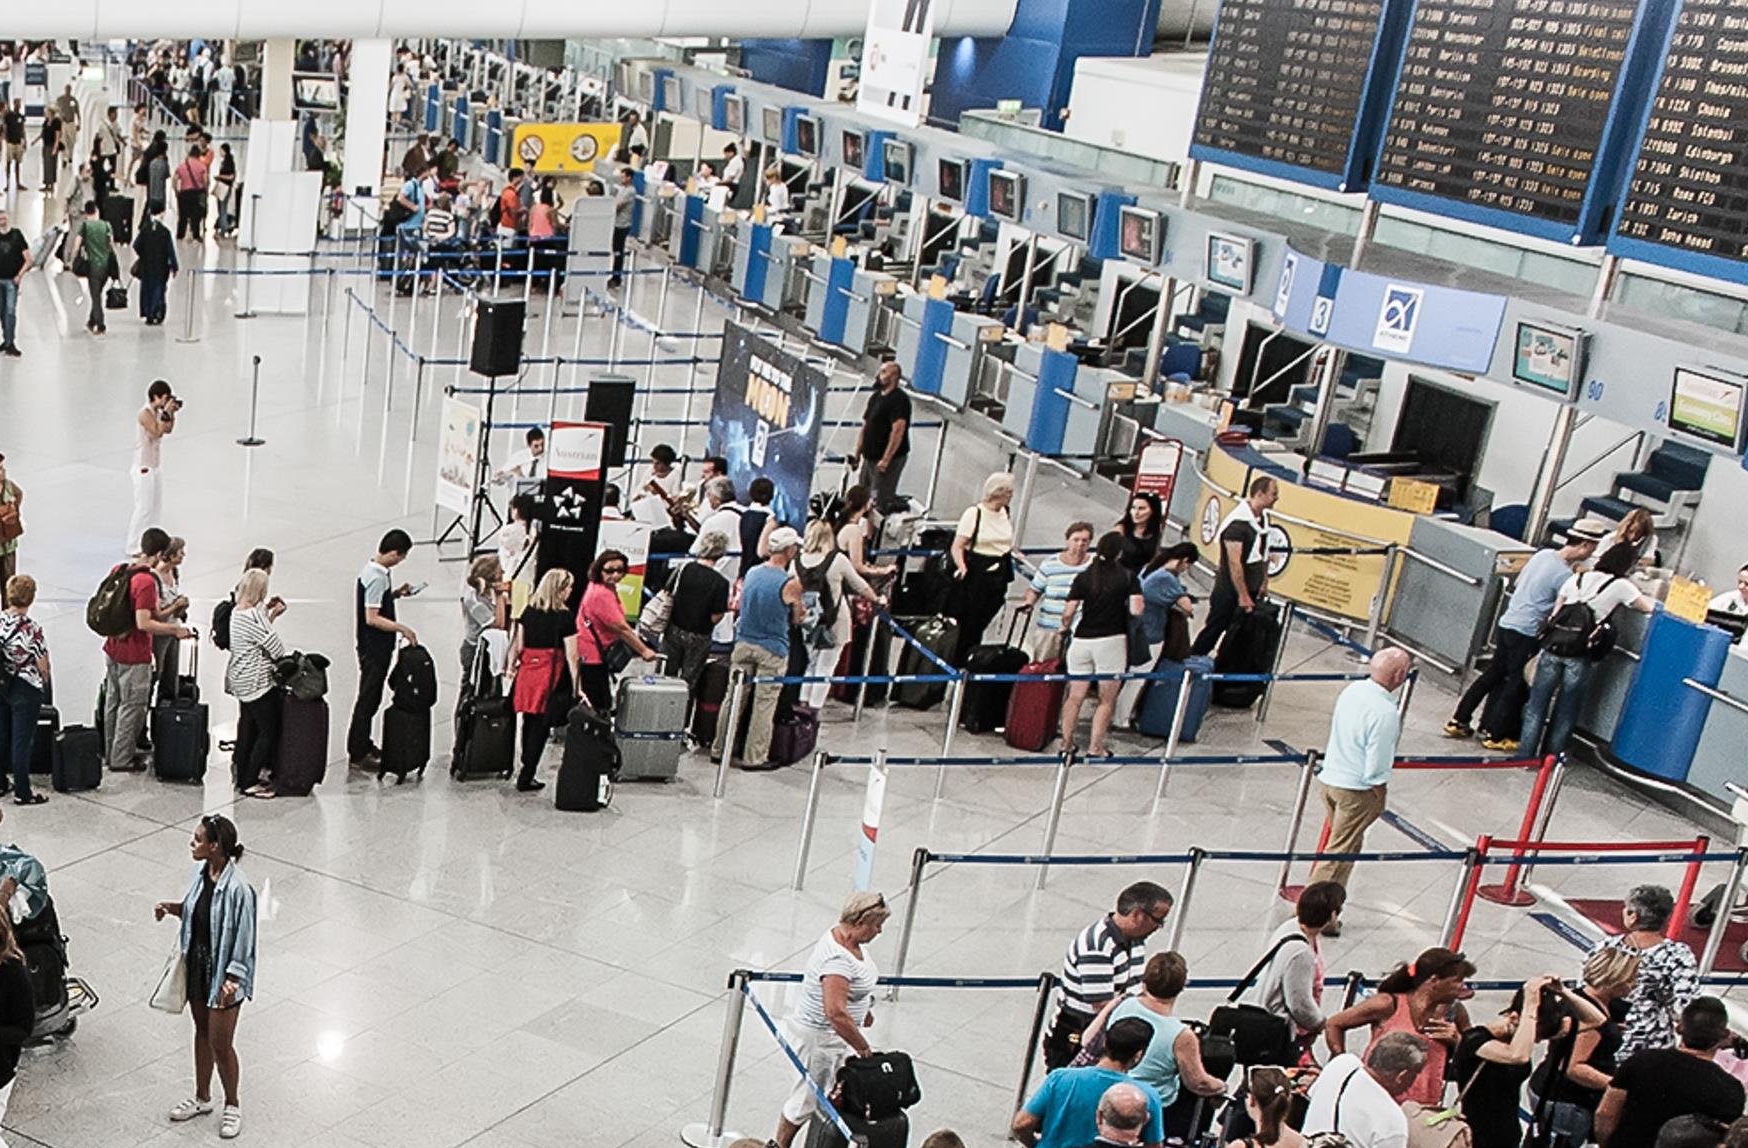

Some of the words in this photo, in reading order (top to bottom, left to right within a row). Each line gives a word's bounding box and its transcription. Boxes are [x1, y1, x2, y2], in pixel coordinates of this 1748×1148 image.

[1665, 207, 1700, 224] Zurich
[1315, 301, 1328, 330] 3
[744, 372, 792, 430] MOON
[1654, 400, 1668, 424] 8
[555, 446, 599, 461] Austrian
